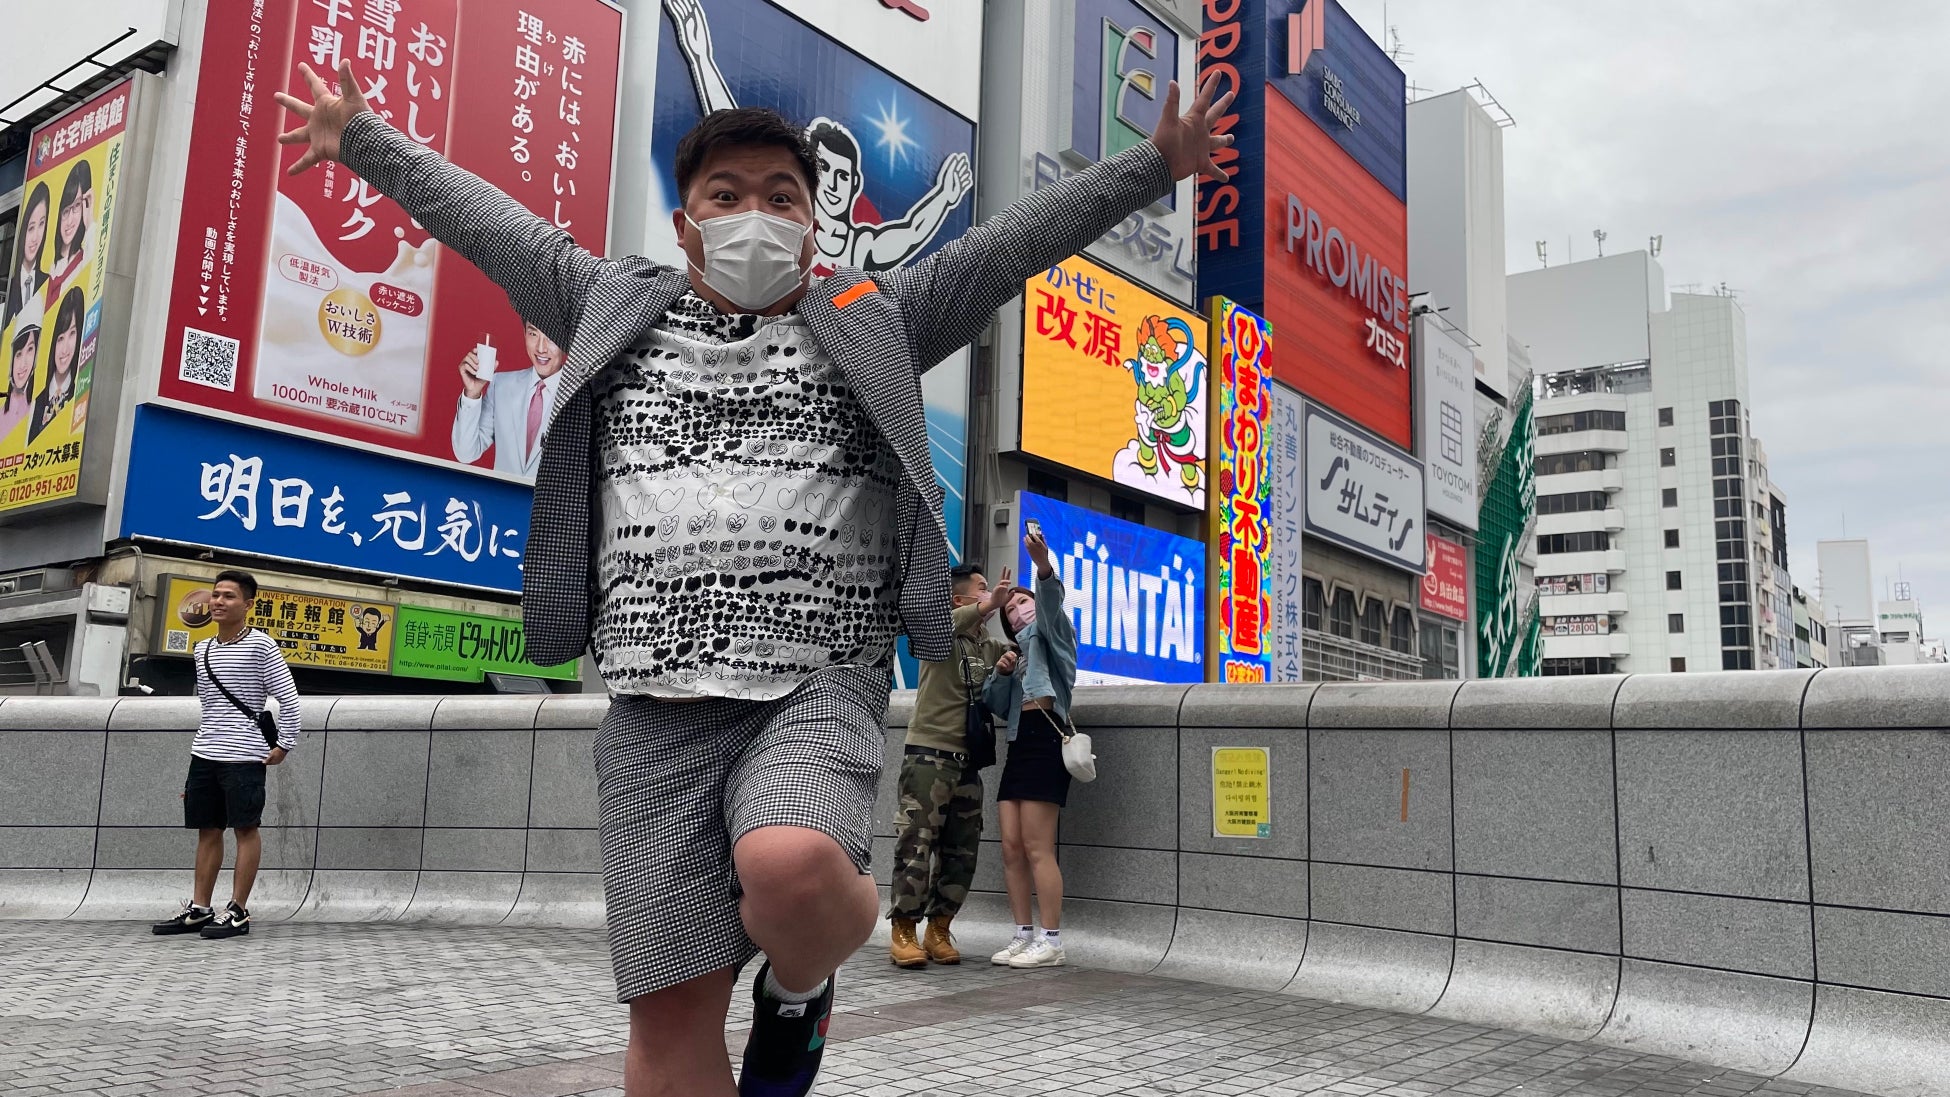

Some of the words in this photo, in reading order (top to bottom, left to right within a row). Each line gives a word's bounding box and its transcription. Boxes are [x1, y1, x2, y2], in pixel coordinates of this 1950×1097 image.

[509, 10, 543, 182] 理由がある。
[1324, 80, 1361, 126] CONSUMER
[1324, 94, 1353, 132] FINANCE
[52, 95, 126, 159] 住宅情報館
[200, 227, 218, 281] 動画公開中
[290, 257, 331, 278] 低温脱気
[1288, 192, 1406, 333] PROMISE
[298, 271, 320, 287] 製法
[378, 285, 416, 305] 赤い遮光
[1046, 264, 1116, 315] かぜに
[325, 300, 376, 325] おいしさ
[376, 297, 415, 315] パッケージ
[327, 319, 373, 344] W技術
[1036, 288, 1122, 368] 改源
[1365, 318, 1406, 369] プロミス
[271, 383, 322, 406] 1000ml
[325, 396, 408, 426] 要冷蔵10℃以下
[308, 375, 350, 395] Whole
[352, 385, 378, 402] Milk
[24, 441, 80, 471] スタッフ大募集
[9, 473, 76, 503] 0120-951-820
[1233, 316, 1262, 653] ひまわり不動産
[254, 598, 345, 626] 舗情報館
[263, 591, 290, 602] INVEST
[292, 595, 346, 608] CORPORATION
